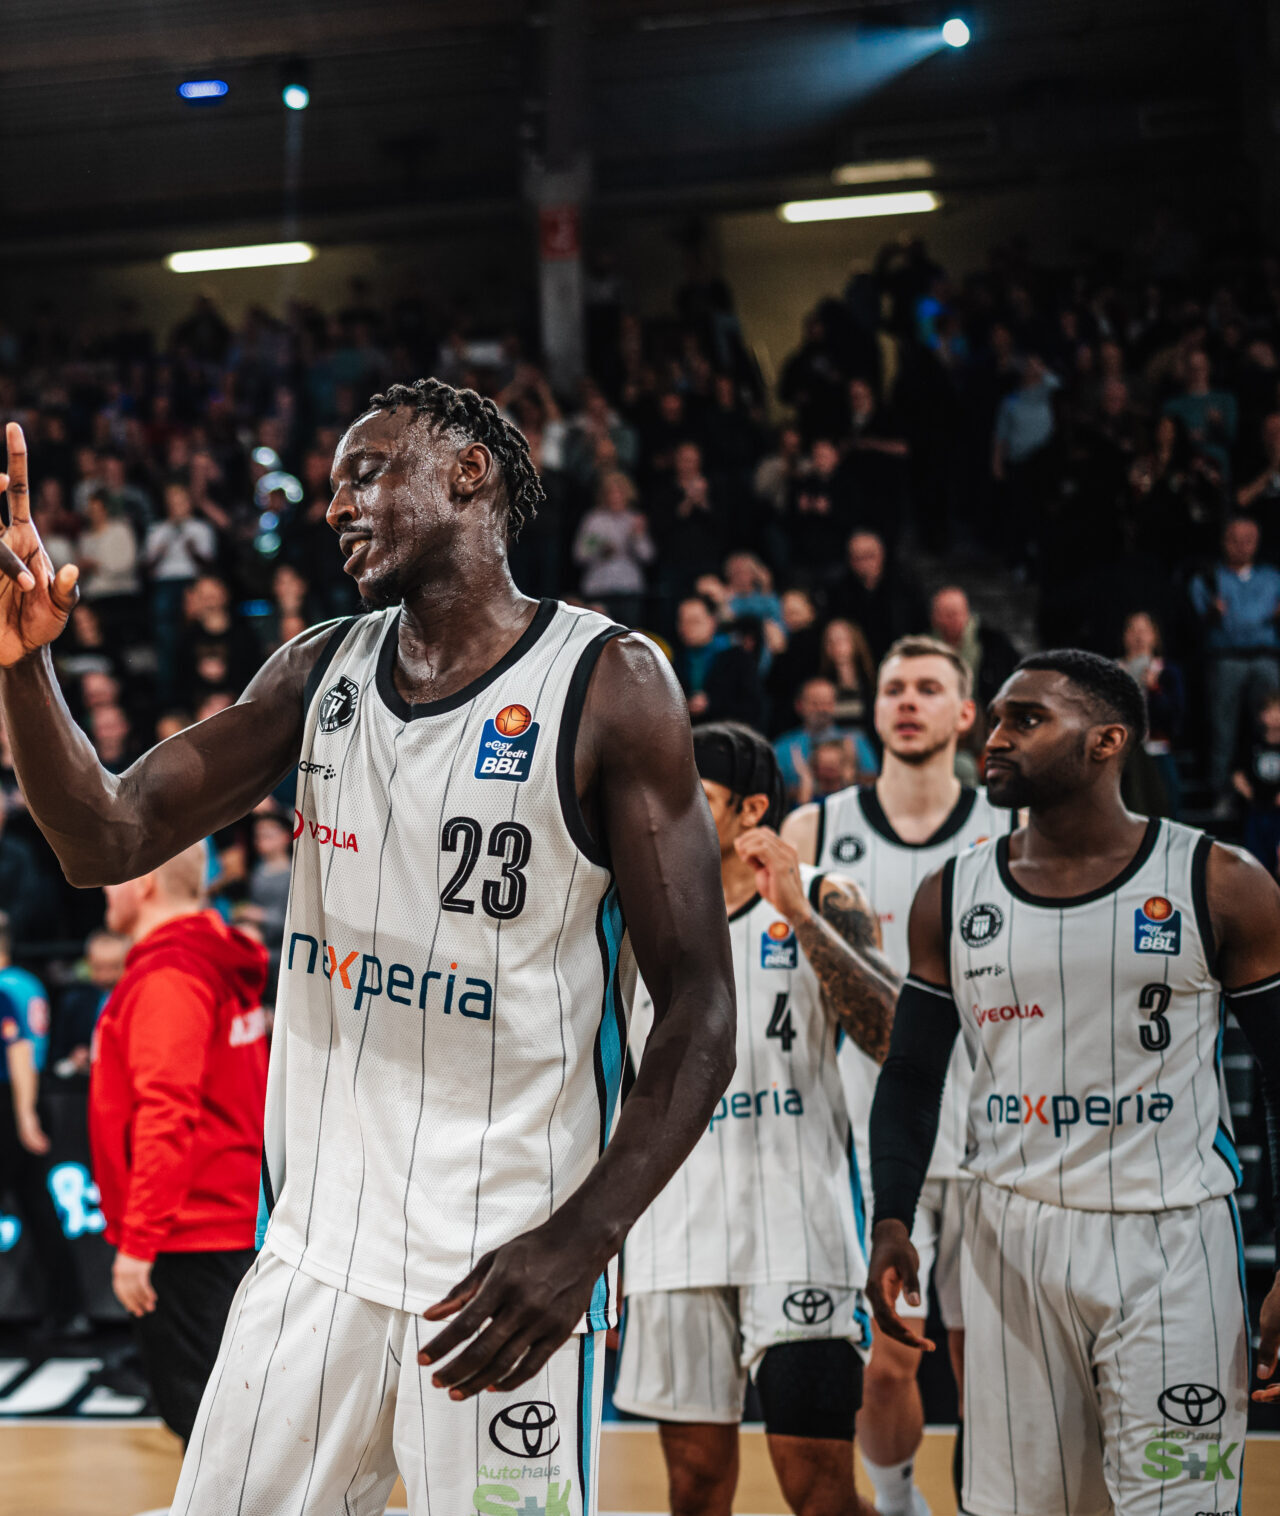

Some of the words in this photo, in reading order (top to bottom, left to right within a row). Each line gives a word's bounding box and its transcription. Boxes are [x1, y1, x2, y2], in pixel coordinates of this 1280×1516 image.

[480, 757, 523, 776] BBL
[440, 816, 532, 920] 23
[1139, 936, 1176, 952] BBL
[765, 992, 798, 1052] 4
[975, 1003, 1045, 1029] VEOLIA
[1138, 982, 1173, 1052] 3
[987, 1085, 1174, 1138] nexperia
[477, 1464, 561, 1480] Autohaus
[1142, 1441, 1239, 1481] S+K
